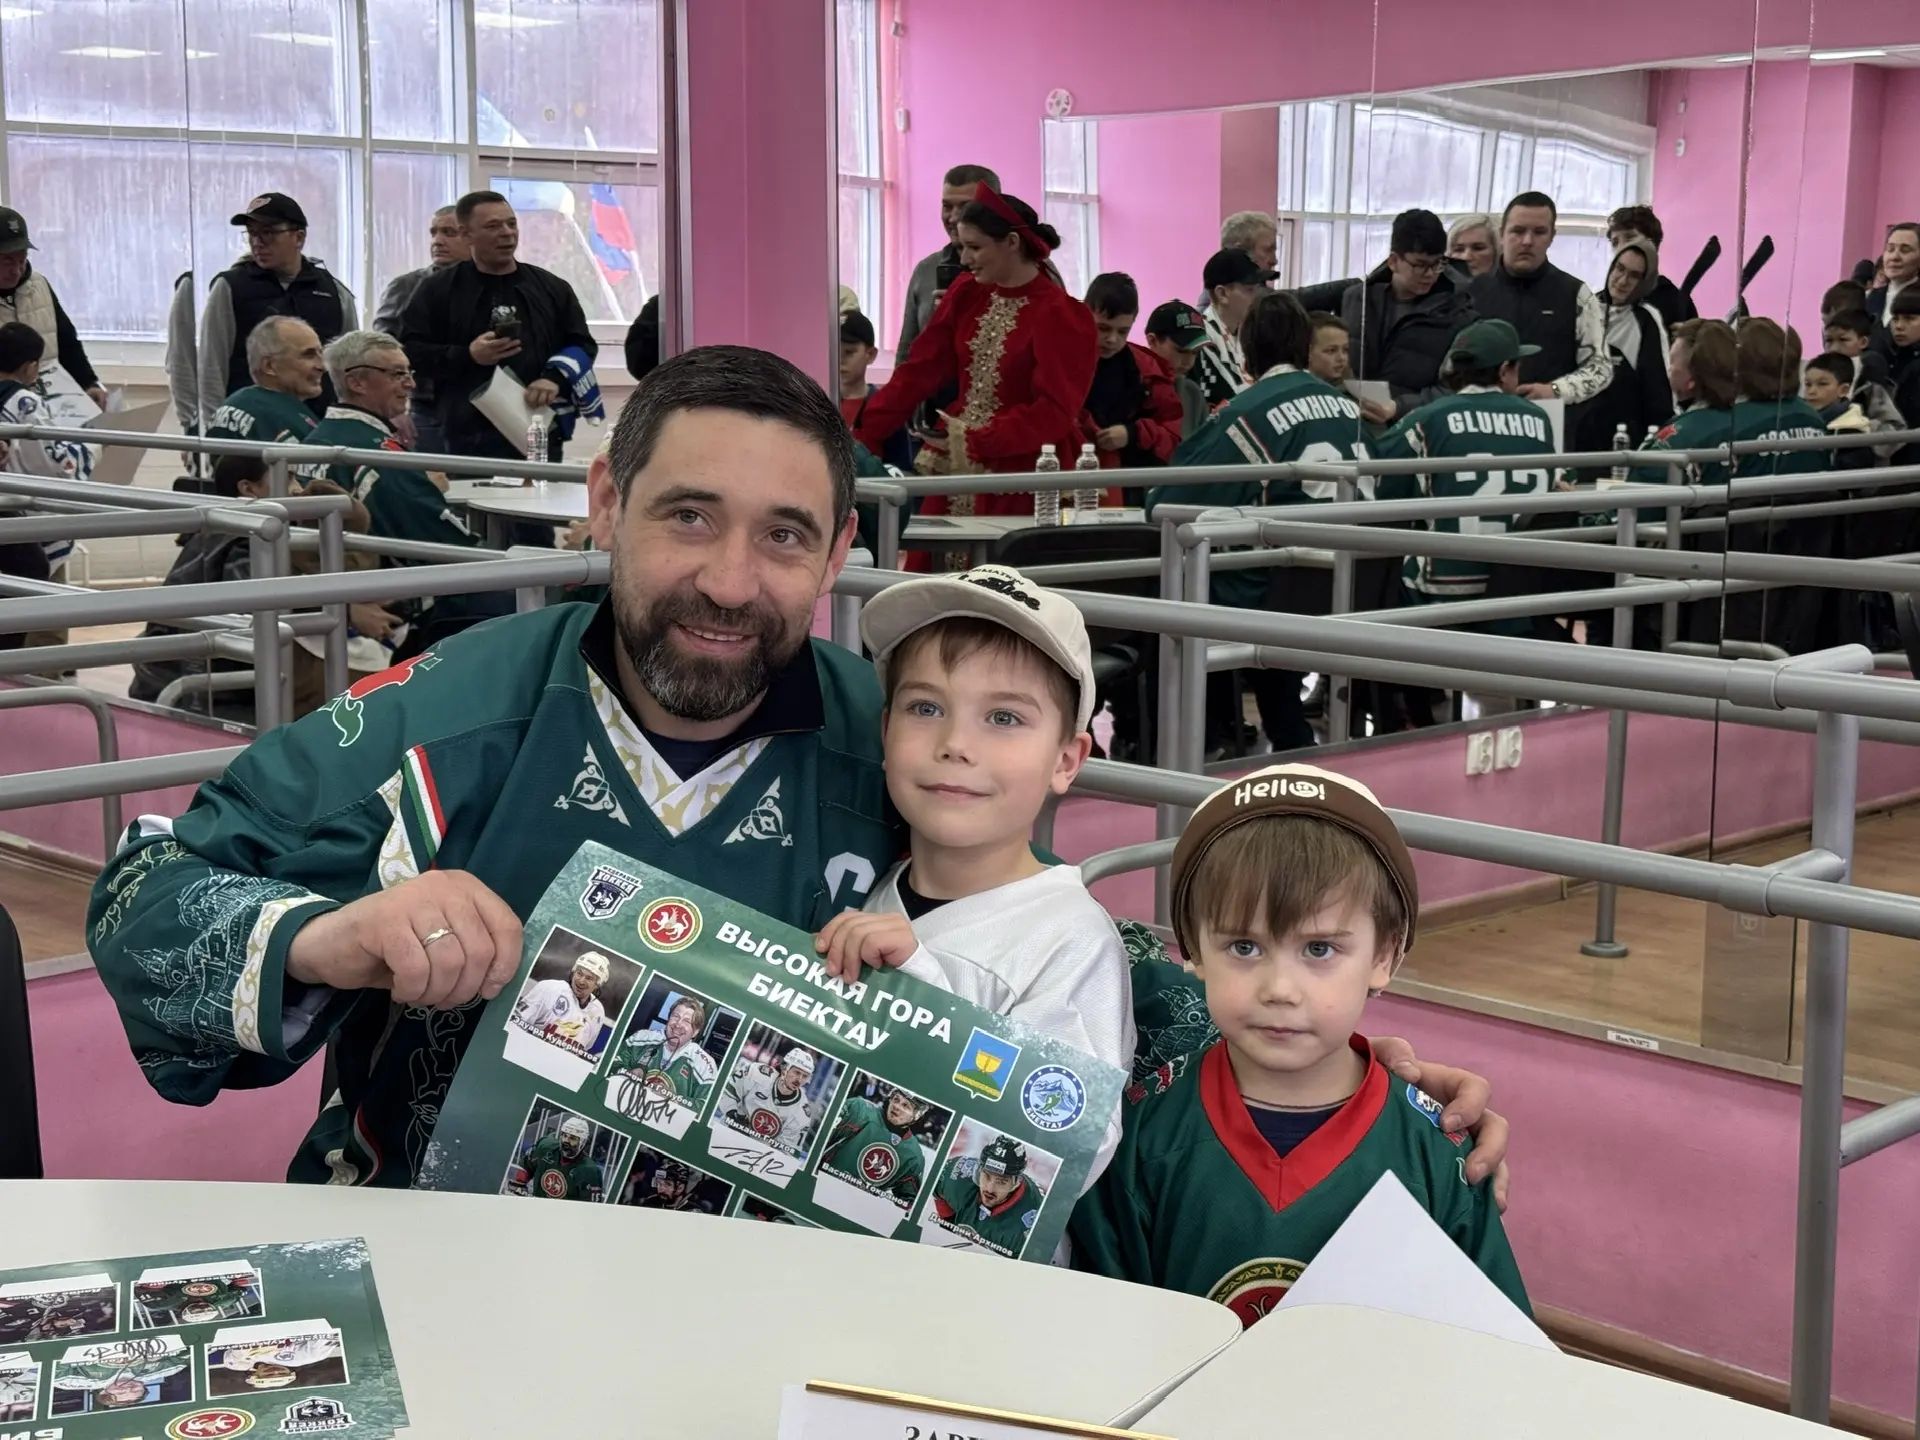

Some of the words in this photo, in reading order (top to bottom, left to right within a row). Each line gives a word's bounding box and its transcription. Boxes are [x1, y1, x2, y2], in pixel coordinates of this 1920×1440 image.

[594, 870, 635, 896] ХОККЕЯ
[715, 921, 869, 1005] ВЫСОКАЯ
[871, 990, 952, 1044] ГОРА
[746, 972, 891, 1051] БИЕКТАУ
[513, 1015, 545, 1038] Эдуард
[1026, 1107, 1063, 1129] БИЕКТАУ
[725, 1117, 762, 1139] Михаил
[763, 1134, 796, 1156] Глухов
[865, 1182, 909, 1208] Токранов
[973, 1233, 1013, 1257] Архипов
